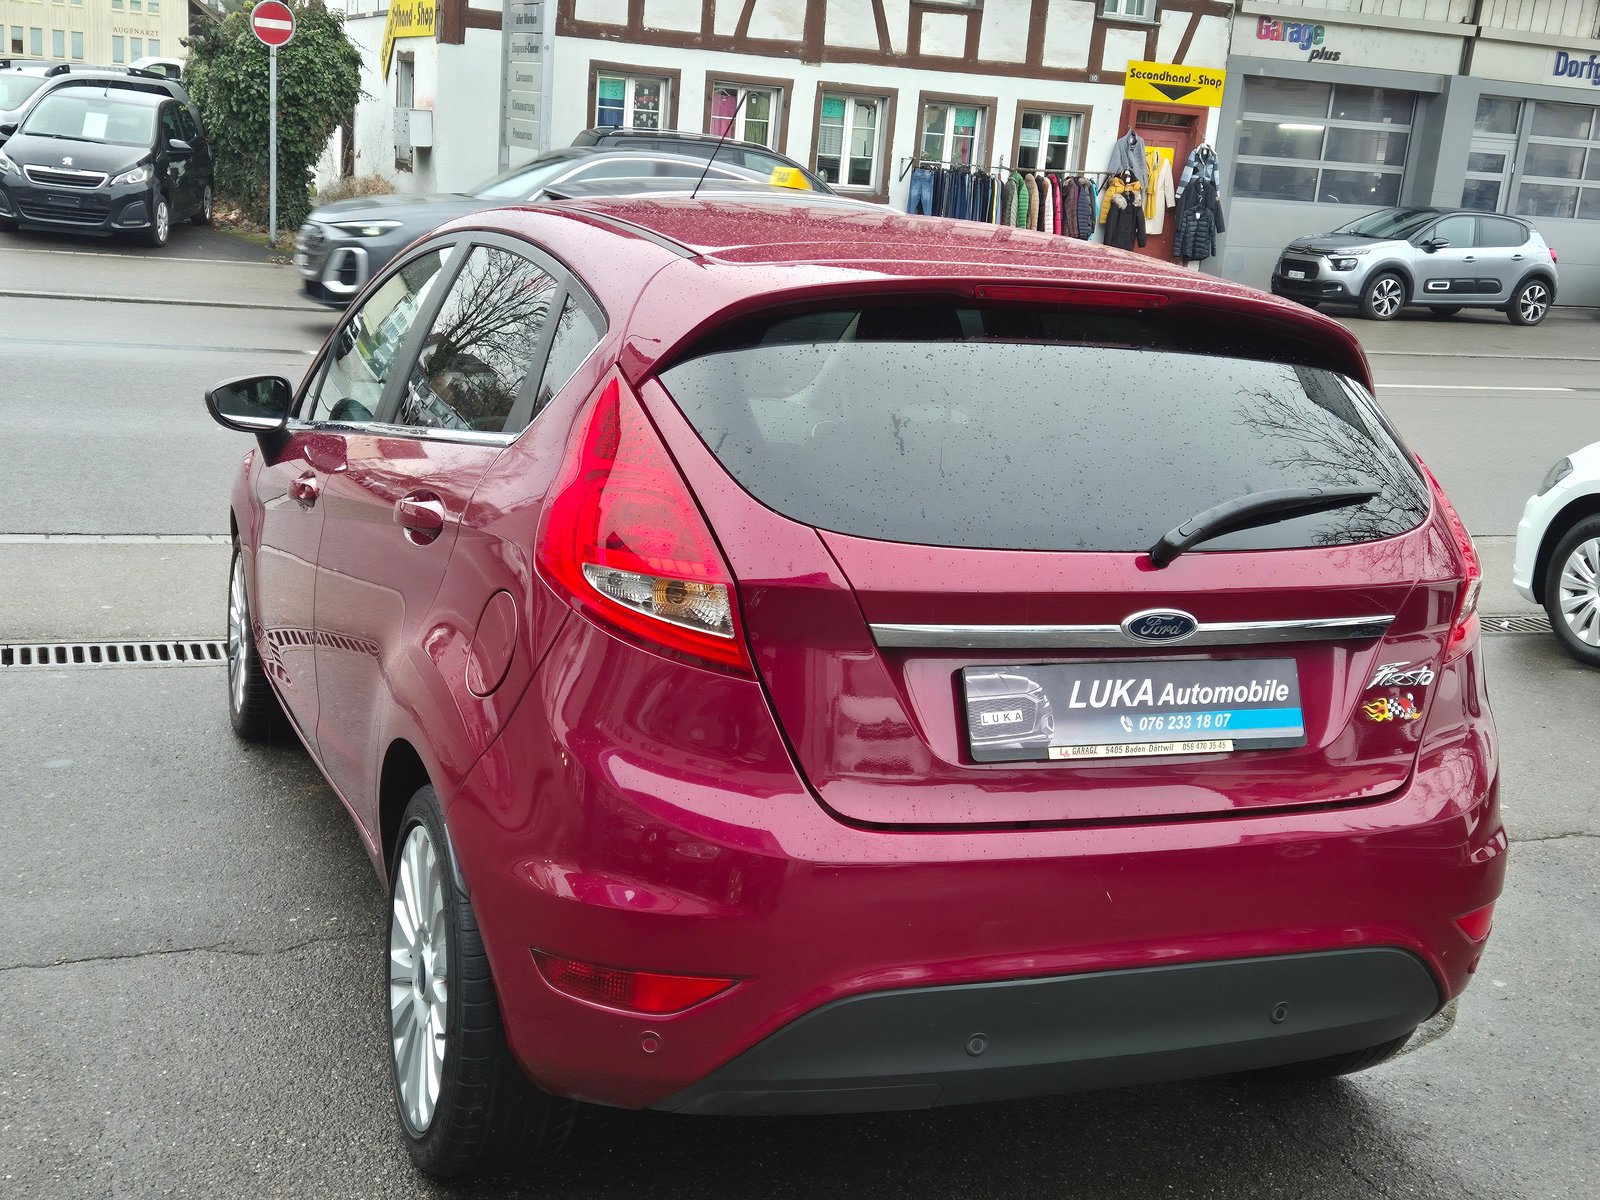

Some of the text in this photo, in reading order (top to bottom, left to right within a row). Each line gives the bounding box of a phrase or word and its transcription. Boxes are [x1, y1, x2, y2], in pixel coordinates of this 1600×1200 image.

[416, 1, 434, 32] Shop
[113, 27, 159, 36] AUGENARZT
[1256, 15, 1326, 50] Garage
[1307, 46, 1341, 62] plus
[1130, 68, 1191, 84] Secondhand
[1198, 74, 1222, 89] Shop
[1140, 615, 1184, 635] Ford
[1366, 661, 1435, 690] Fiesta
[1069, 678, 1289, 709] LUKA Automobile
[982, 712, 1022, 724] LUKA
[1139, 713, 1232, 731] 076 233 18 07
[1072, 746, 1098, 755] GARAGE
[1105, 745, 1123, 755] 5405
[1182, 743, 1195, 751] 056
[1196, 742, 1208, 750] 470
[1209, 742, 1217, 750] 35
[1218, 741, 1226, 749] 45
